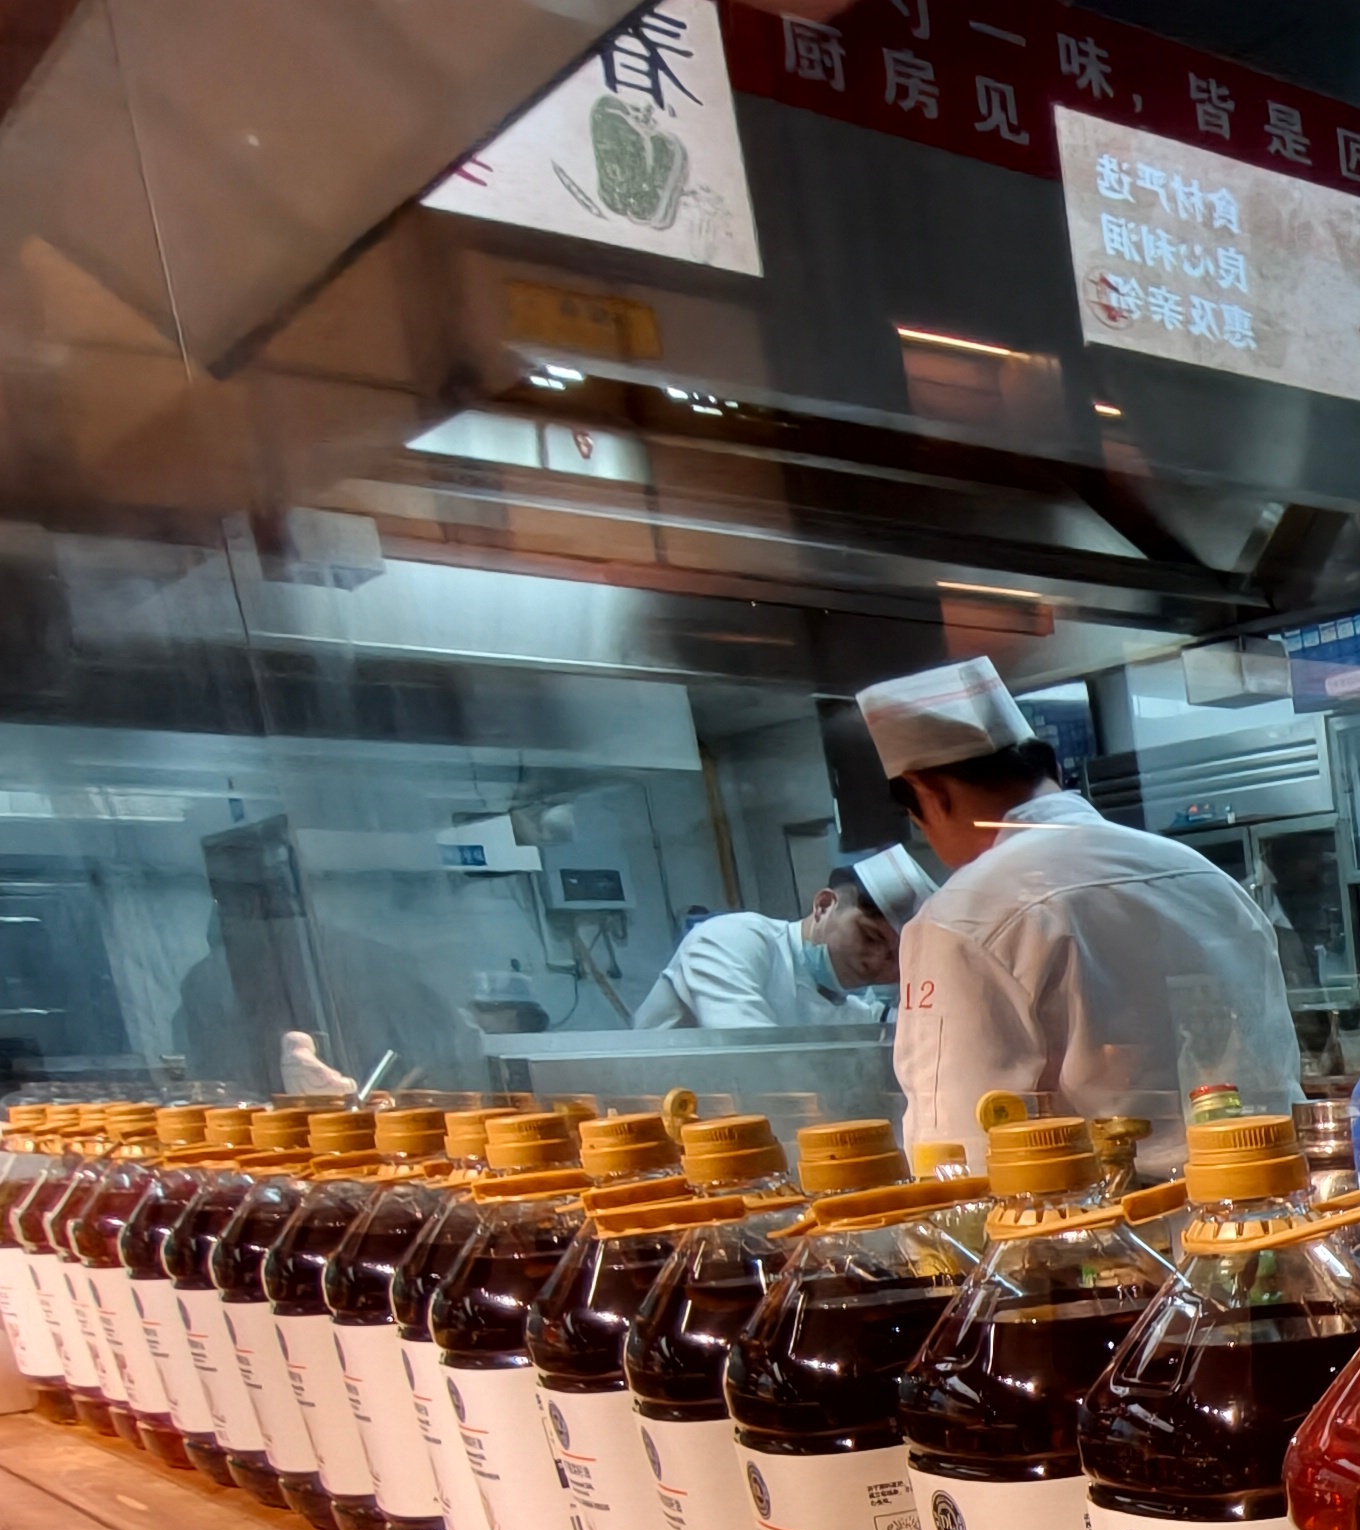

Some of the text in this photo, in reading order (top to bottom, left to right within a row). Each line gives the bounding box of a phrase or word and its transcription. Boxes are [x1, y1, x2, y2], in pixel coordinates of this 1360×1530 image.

[781, 14, 1030, 147] 厨房见
[904, 980, 935, 1010] 12
